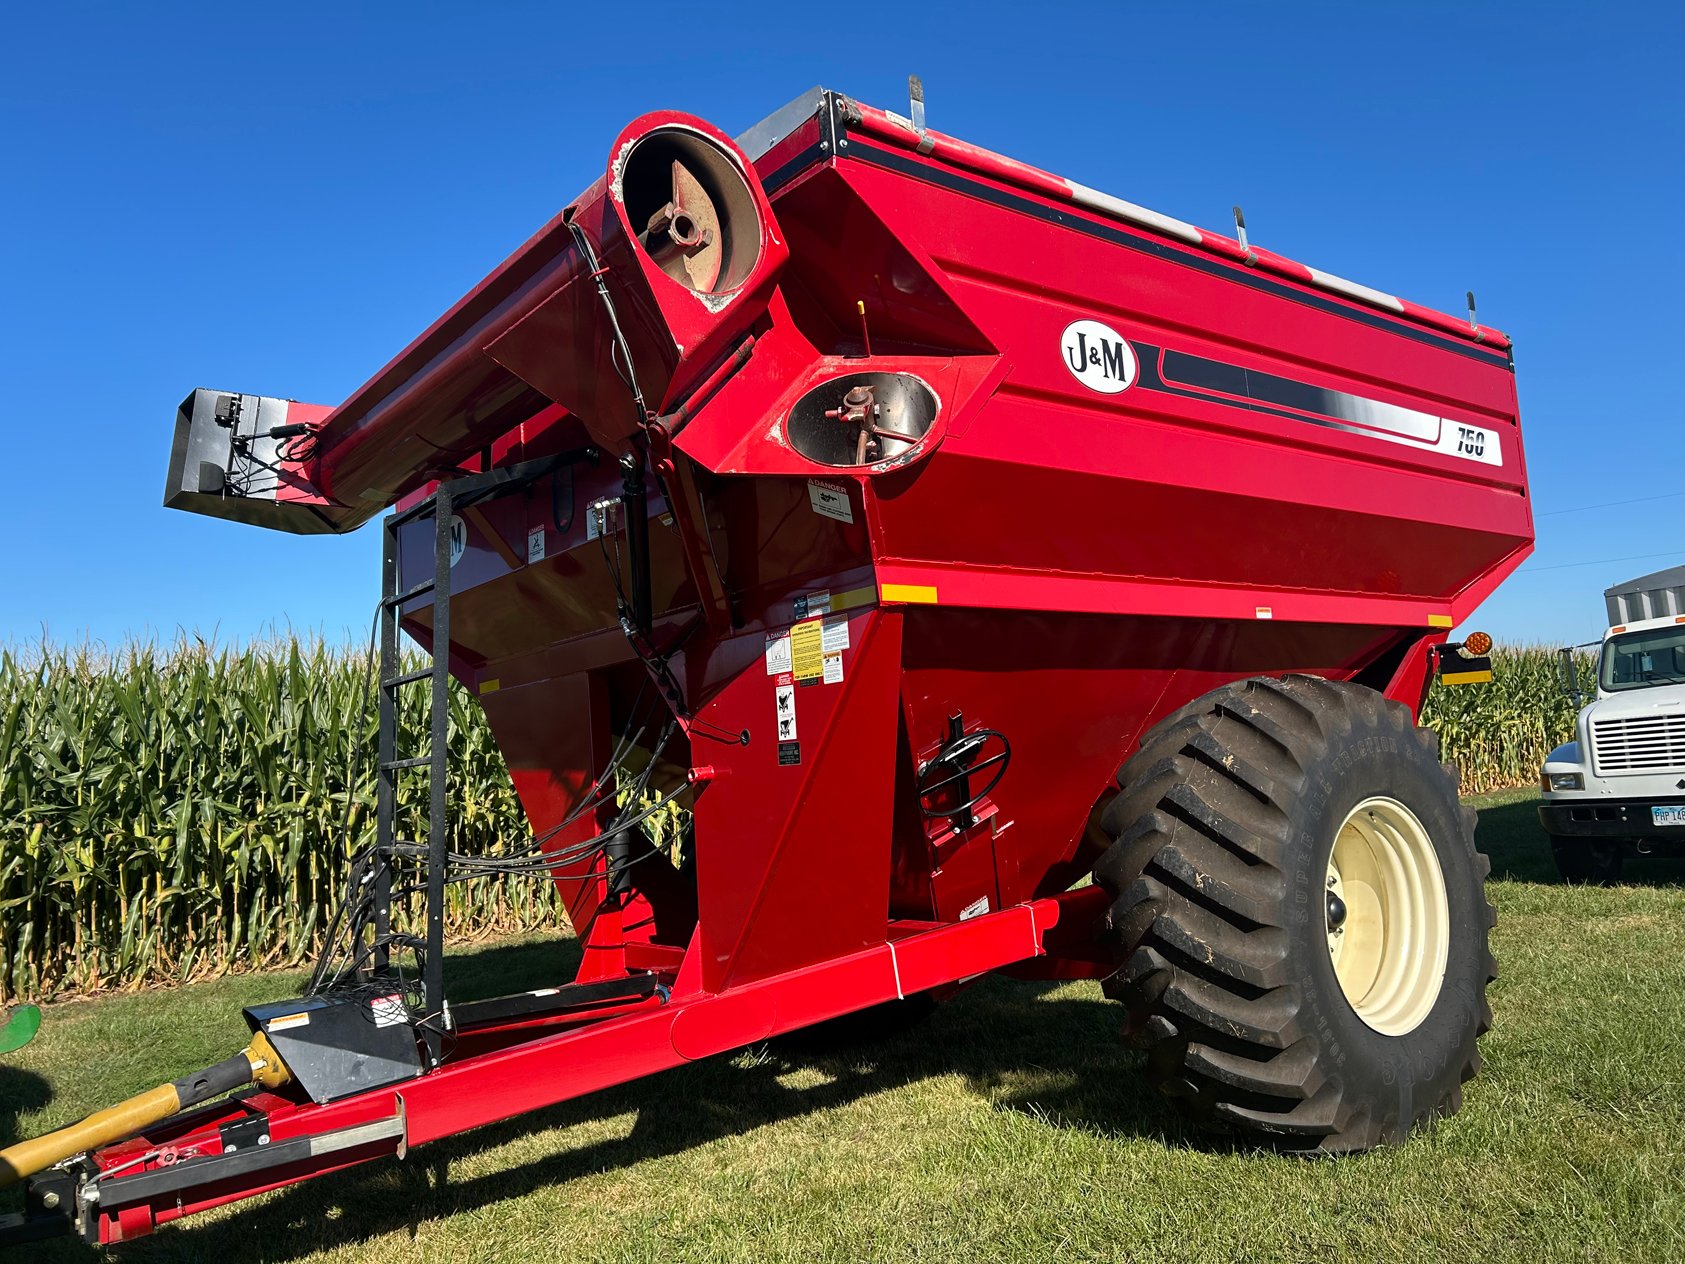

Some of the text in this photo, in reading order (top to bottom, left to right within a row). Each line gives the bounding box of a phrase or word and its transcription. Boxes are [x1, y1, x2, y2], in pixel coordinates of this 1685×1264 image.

[1067, 331, 1127, 383] J&M
[1457, 426, 1485, 457] 750
[814, 479, 847, 494] DANGER
[770, 630, 790, 639] DANGER
[1655, 811, 1670, 821] PHP
[1296, 832, 1314, 922] SUPER
